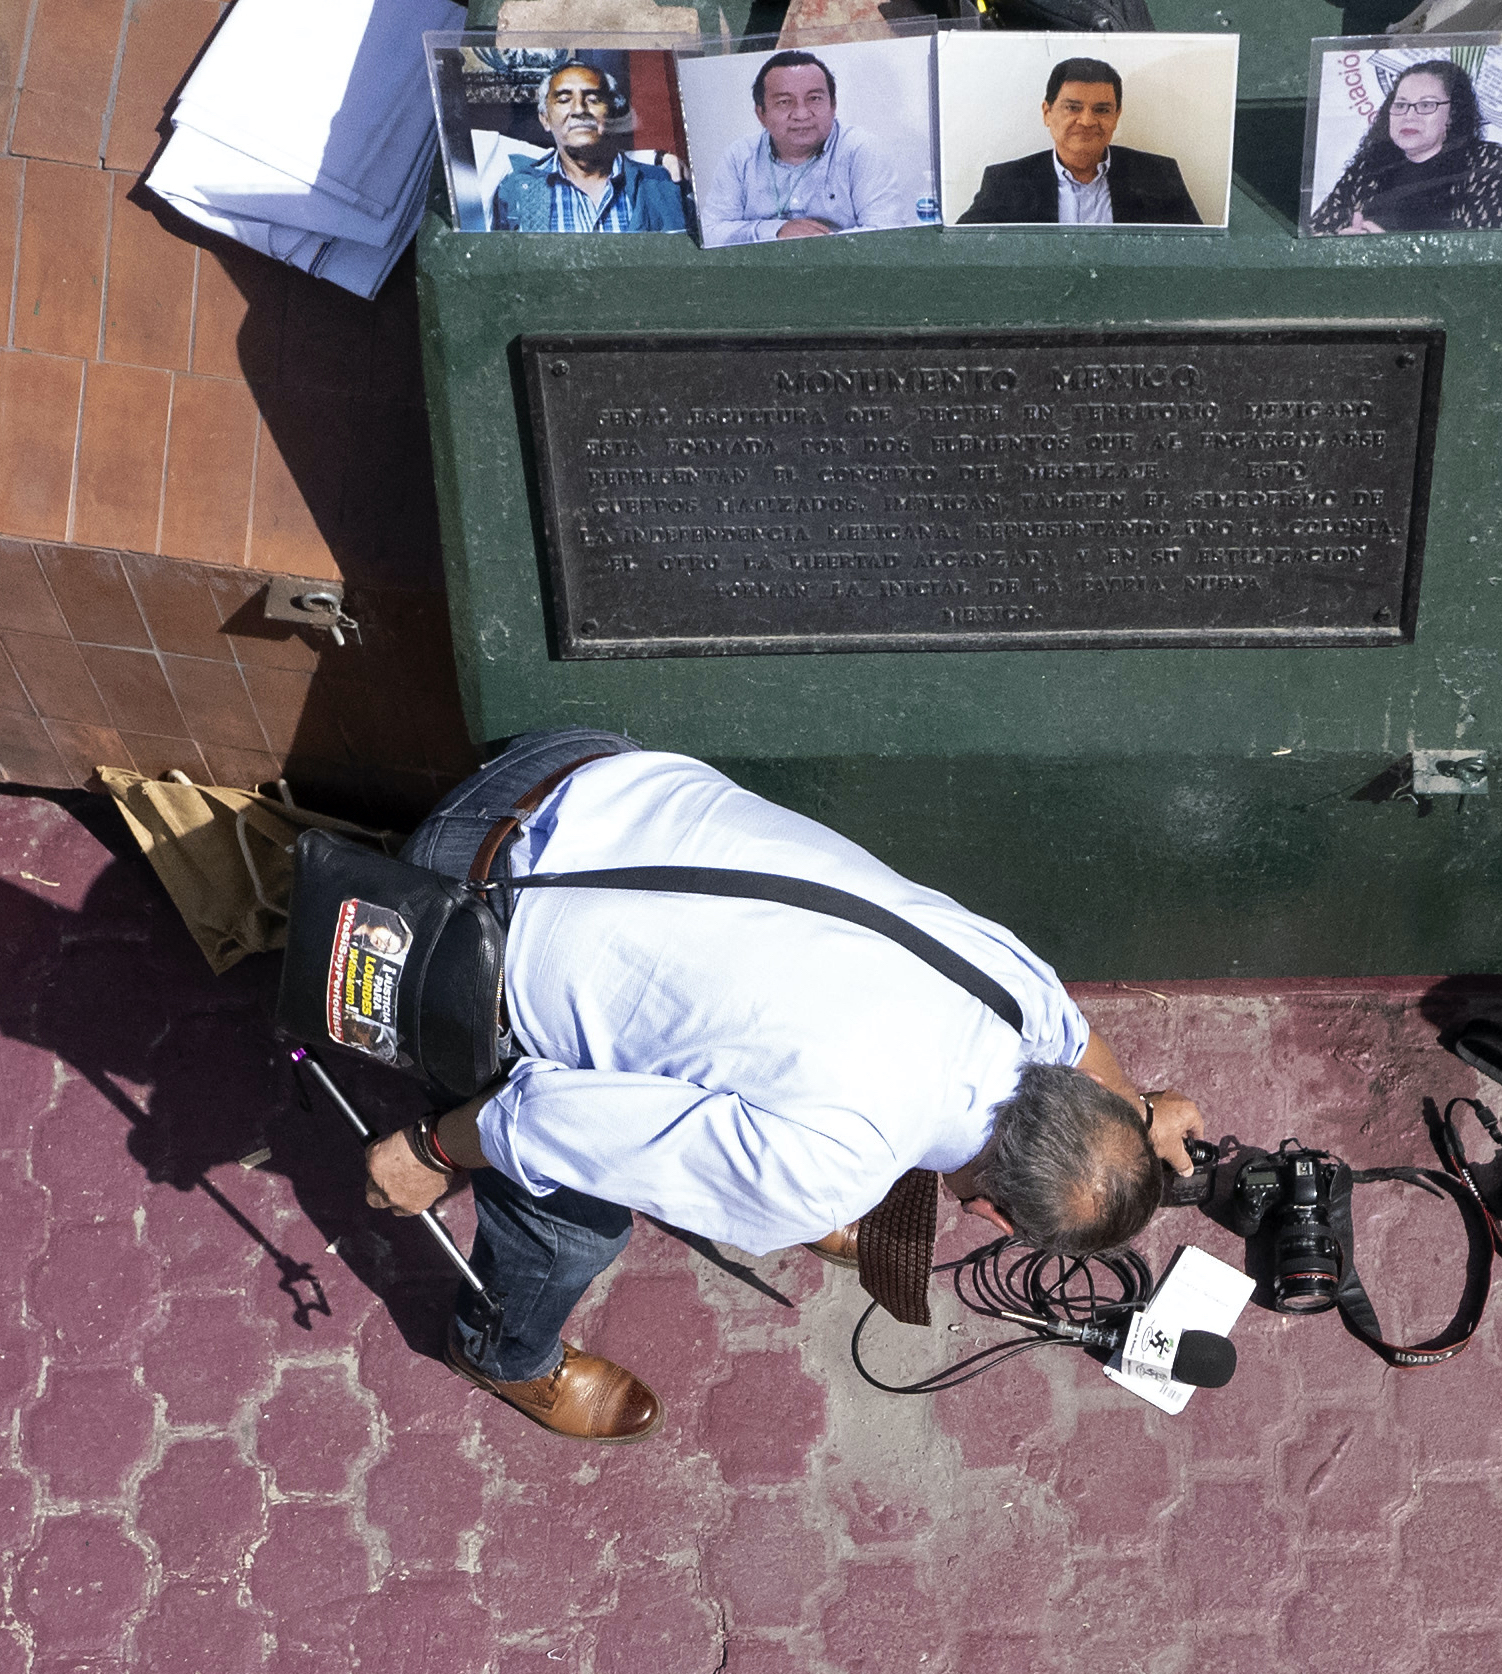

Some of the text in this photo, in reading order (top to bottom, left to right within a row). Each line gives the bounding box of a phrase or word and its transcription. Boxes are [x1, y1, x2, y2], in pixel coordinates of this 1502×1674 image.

[775, 364, 1201, 394] MONUMENTO MEXICO
[689, 406, 826, 425] ESCULTURA
[845, 405, 893, 423] QUE
[918, 404, 1004, 422] RECIBE
[1023, 402, 1055, 420] EN
[1071, 401, 1220, 420] TERRITORIO
[1246, 400, 1374, 418] MEXICANO
[586, 438, 648, 457] ESTA
[666, 437, 778, 455] FORMADA
[801, 437, 849, 454] POR
[864, 436, 911, 453] DOS
[931, 433, 1071, 452] ELEMENTOS
[1086, 432, 1136, 451] QUE
[1154, 431, 1183, 450] AL
[588, 466, 748, 486] REPRESENTAN
[773, 465, 798, 482] EL
[818, 465, 938, 483] CONCEPTO
[958, 463, 1002, 482] DEL
[592, 497, 698, 515] CUERPOS
[884, 493, 1002, 512] IMPLICAN
[1020, 491, 1127, 510] TAMBIEN
[1143, 490, 1172, 508] EL
[1350, 488, 1385, 507] DE
[578, 526, 614, 546] LA
[623, 525, 811, 544] INDEPENDENCIA
[975, 519, 1172, 540] REPRESENTANDO
[1185, 518, 1235, 536] UNO
[608, 555, 639, 573] EL
[658, 554, 719, 572] OTRO
[744, 553, 775, 571] LA
[789, 551, 900, 570] LIBERTAD
[913, 549, 1059, 569] ALCANZADA
[1106, 547, 1138, 565] EN
[1151, 546, 1182, 565] SU
[713, 581, 810, 600] FORMAN
[831, 580, 863, 599] LA
[879, 578, 970, 597] INICIAL
[987, 577, 1021, 596] DE
[1030, 576, 1064, 595] LA
[1078, 575, 1167, 594] PATRIA
[355, 978, 362, 987] Y
[362, 955, 376, 1017] LOURDES
[373, 975, 384, 1011] PARA
[1394, 1351, 1454, 1363] Canon
